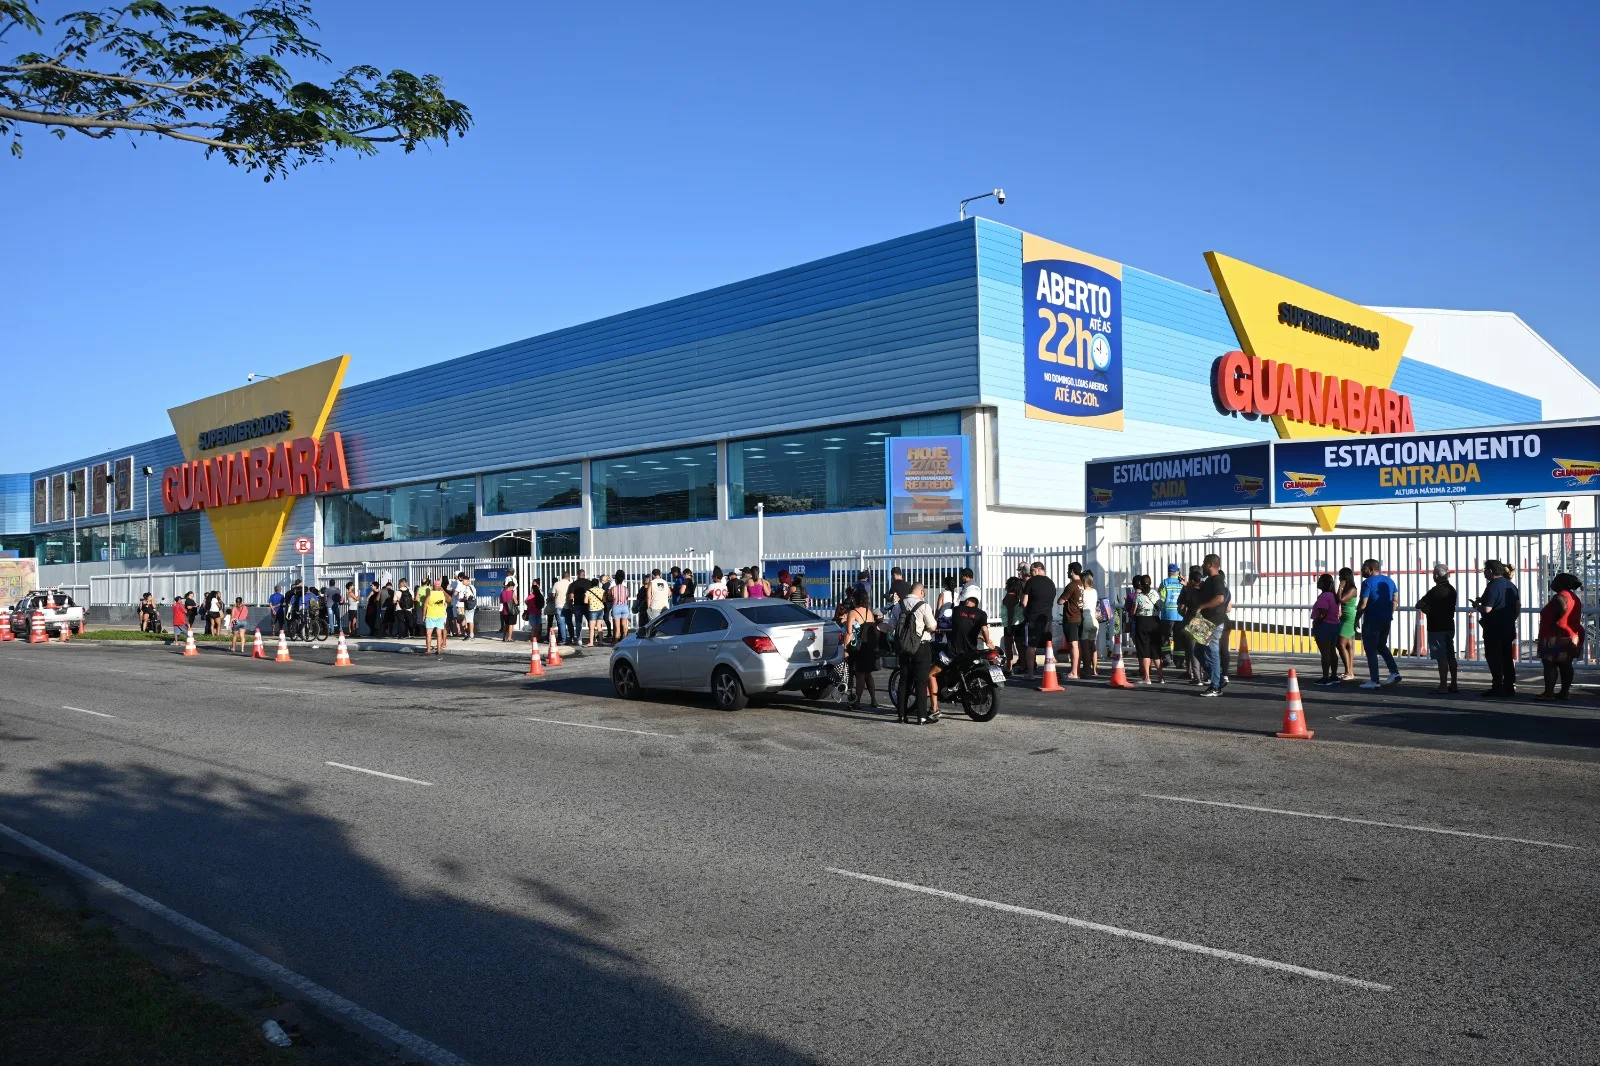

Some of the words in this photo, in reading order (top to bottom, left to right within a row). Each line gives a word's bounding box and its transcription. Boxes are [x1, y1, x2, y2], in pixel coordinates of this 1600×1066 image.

[1036, 269, 1111, 318] ABERTO
[1038, 308, 1094, 370] 22h
[1089, 317, 1101, 332] ATÉ
[1102, 320, 1112, 334] AS
[1278, 302, 1380, 350] SUPERMERCADOS
[1044, 372, 1052, 382] NO
[1217, 350, 1416, 434] GUANABARA
[1055, 385, 1070, 402] ATÉ
[1071, 389, 1082, 405] AS
[198, 410, 292, 450] SUPERMERCADOS
[1323, 434, 1541, 468] ESTACIONAMENTO
[161, 431, 350, 514] GUANABARA
[1113, 453, 1231, 483] ESTACIONAMENTO
[1379, 462, 1481, 487] ENTRADA
[1395, 488, 1419, 496] ALTURA
[1420, 486, 1446, 494] MÁXIMA
[789, 565, 806, 575] UBER
